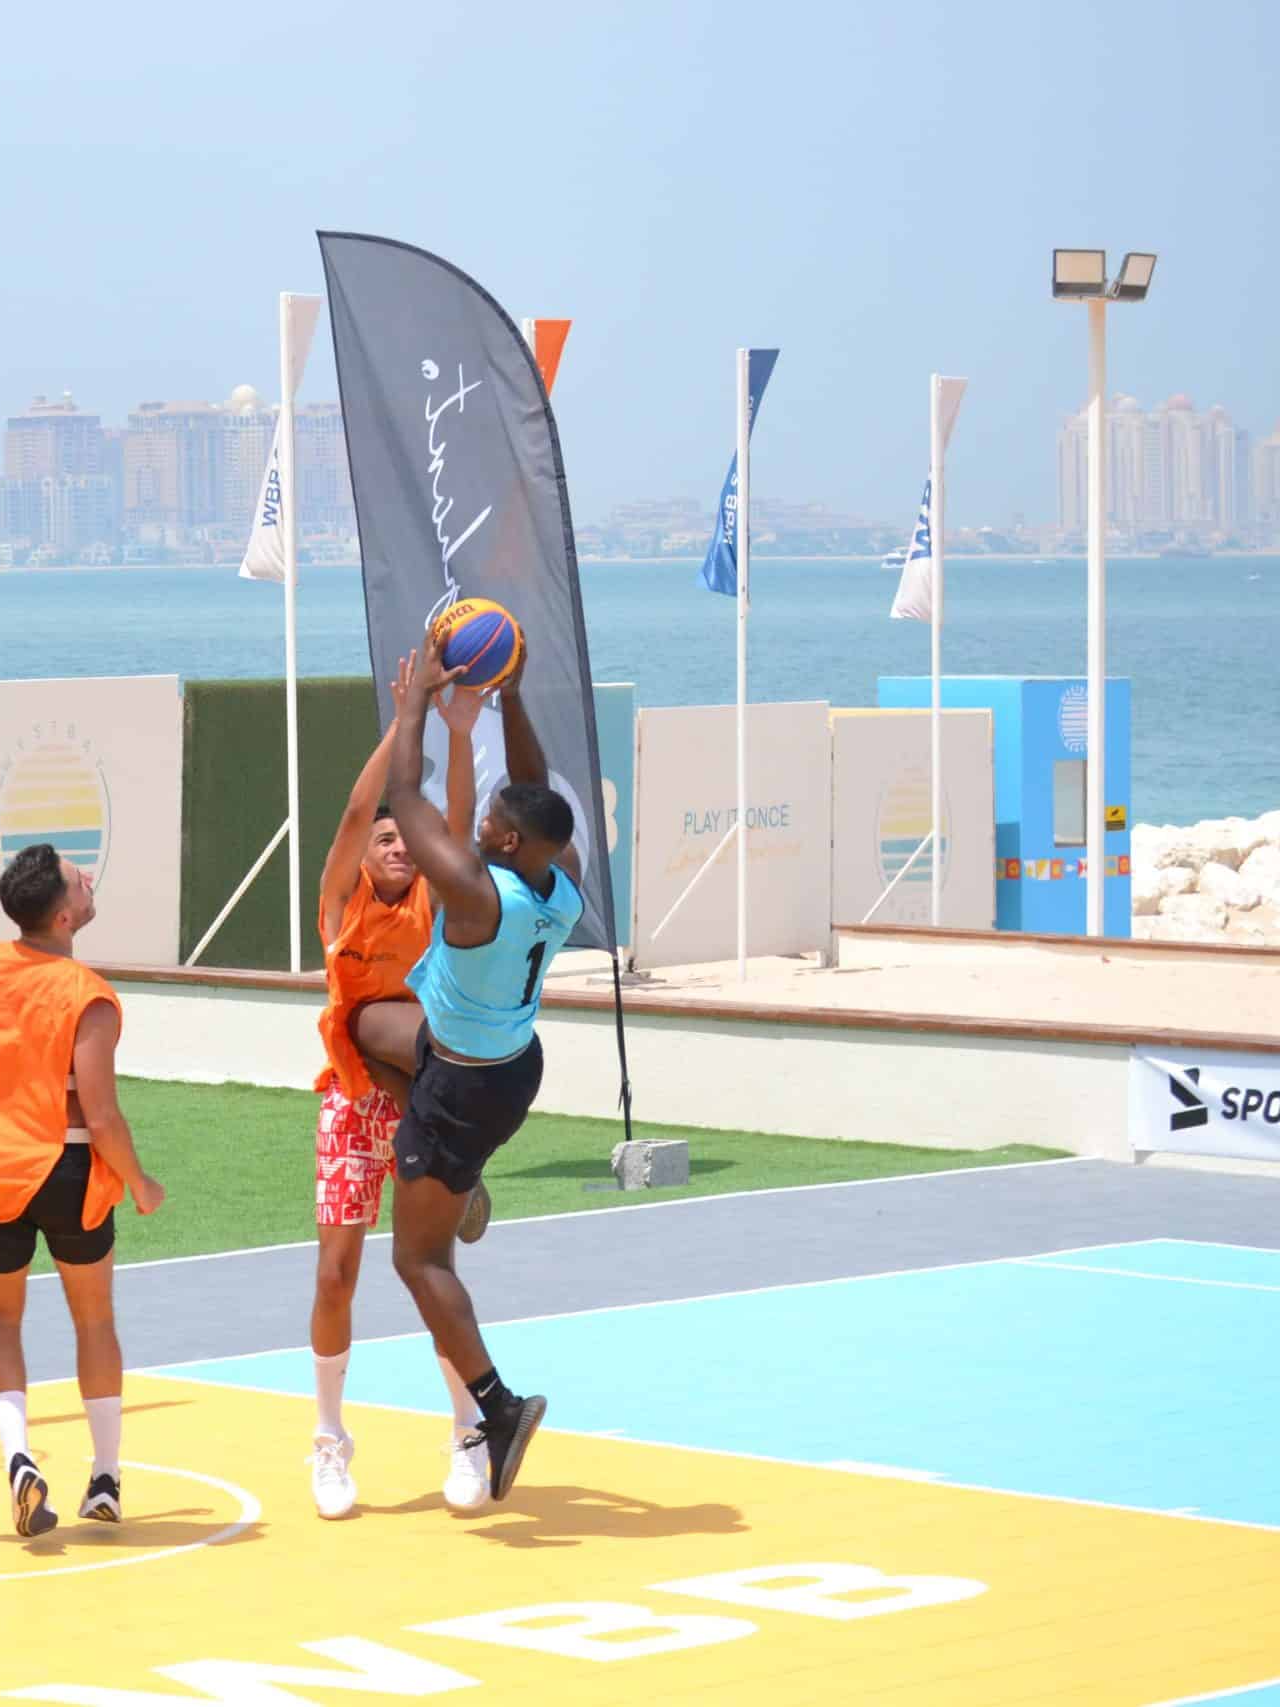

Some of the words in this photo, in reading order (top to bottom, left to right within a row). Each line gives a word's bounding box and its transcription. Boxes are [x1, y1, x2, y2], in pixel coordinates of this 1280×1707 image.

[683, 808, 721, 835] PLAY
[745, 804, 792, 829] ONCE
[521, 940, 547, 1006] 1
